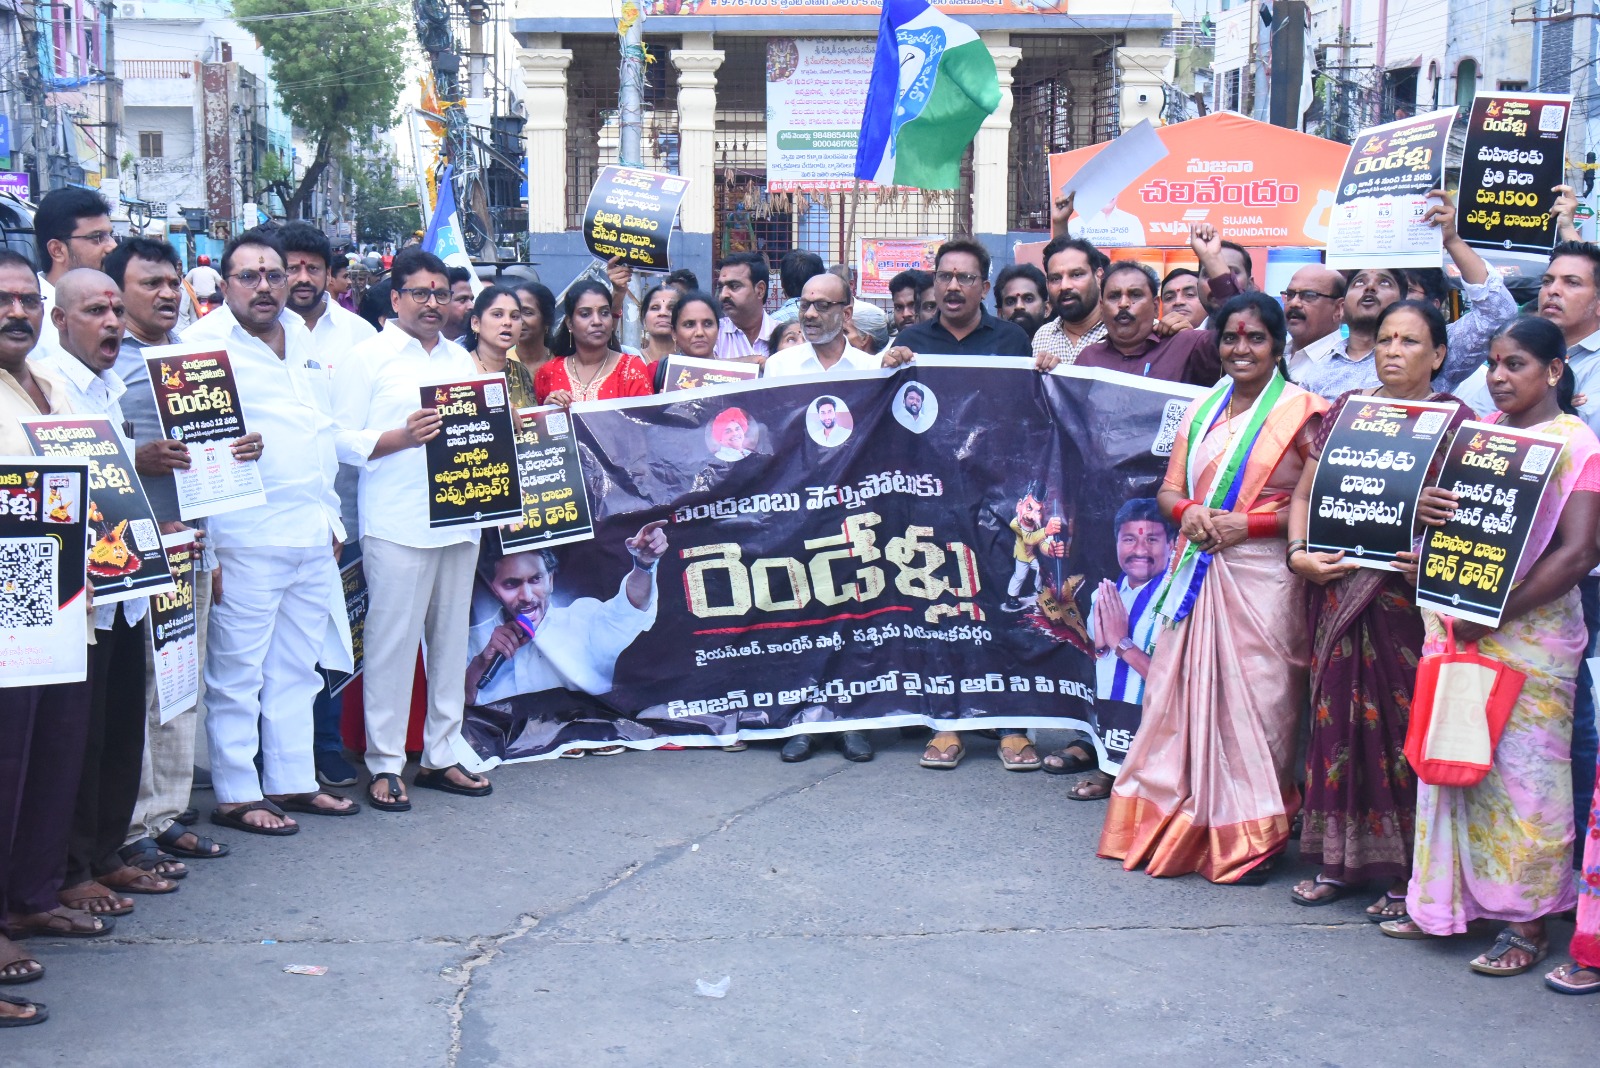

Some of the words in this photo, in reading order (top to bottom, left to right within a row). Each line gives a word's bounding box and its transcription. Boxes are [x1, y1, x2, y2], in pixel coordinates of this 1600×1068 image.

[813, 131, 858, 139] 9848654414,
[1483, 117, 1528, 137] రెండేళ్లు
[1186, 158, 1253, 172] సుజనా
[1354, 146, 1432, 176] రెండేళ్లు
[1478, 146, 1544, 164] మహిళలకు
[1401, 174, 1412, 182] 12
[1482, 168, 1504, 188] ప్రతి
[1507, 170, 1534, 185] నెలా
[1138, 176, 1299, 207] చలివేంద్రం
[1476, 189, 1538, 206] రూ.1500
[1222, 216, 1262, 225] SUJANA
[1467, 210, 1501, 230] ఎక్కడ
[1504, 213, 1550, 232] బాబూ?
[592, 225, 618, 242] చేసిన
[1222, 228, 1288, 237] FOUNDATION
[594, 243, 628, 258] జవాబు
[182, 358, 218, 371] చంద్రబాబు
[166, 384, 234, 415] రెండేళ్లు
[215, 418, 224, 426] 12
[446, 420, 490, 436] అన్నదాతలకు
[1350, 418, 1402, 437] రెండేళ్లు
[35, 426, 96, 442] చంద్రబాబు
[447, 437, 468, 448] బాబు
[1328, 446, 1416, 472] యువతకు
[1462, 450, 1510, 476] రెండేళ్లు
[435, 469, 470, 484] అన్నదాత
[1340, 474, 1386, 496] బాబు
[671, 492, 800, 524] చంద్రబాబు
[805, 470, 944, 510] వెన్నుపోటుకు
[545, 502, 578, 525] డౌన్
[1318, 496, 1405, 526] వెన్నుపోటు!
[1430, 530, 1473, 552] మోసాల
[1474, 542, 1507, 562] బాబు
[679, 512, 986, 622] రెండేళ్లు
[1426, 554, 1459, 582] డౌన్
[1458, 561, 1504, 592] డౌన్!
[767, 635, 814, 656] కాంగ్రెస్
[816, 630, 846, 652] పార్టీ,
[853, 624, 901, 647] పశ్చిమ
[667, 690, 749, 718] డివిజన్
[754, 690, 773, 707] ల
[960, 674, 1006, 696] ఆర్
[1010, 676, 1031, 694] సి
[1035, 676, 1054, 693] పి
